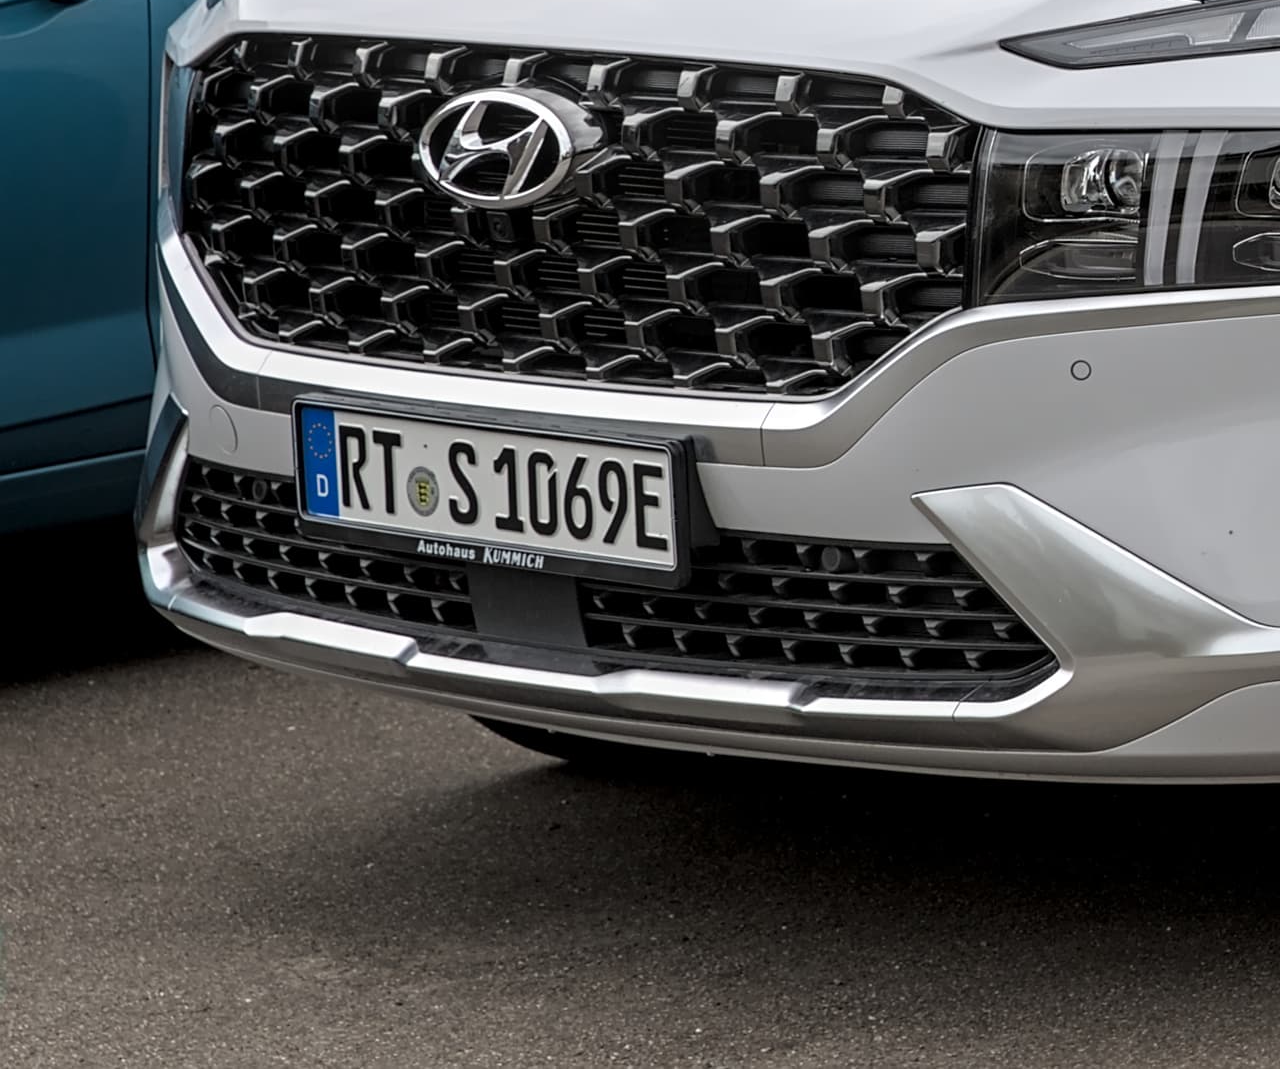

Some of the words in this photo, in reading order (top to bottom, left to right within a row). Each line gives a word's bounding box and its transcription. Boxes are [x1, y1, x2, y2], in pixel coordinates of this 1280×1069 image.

[316, 473, 329, 498] D
[337, 424, 403, 515] RT
[448, 440, 479, 525] S
[493, 445, 669, 551] 1069E
[417, 539, 476, 560] Autohaus
